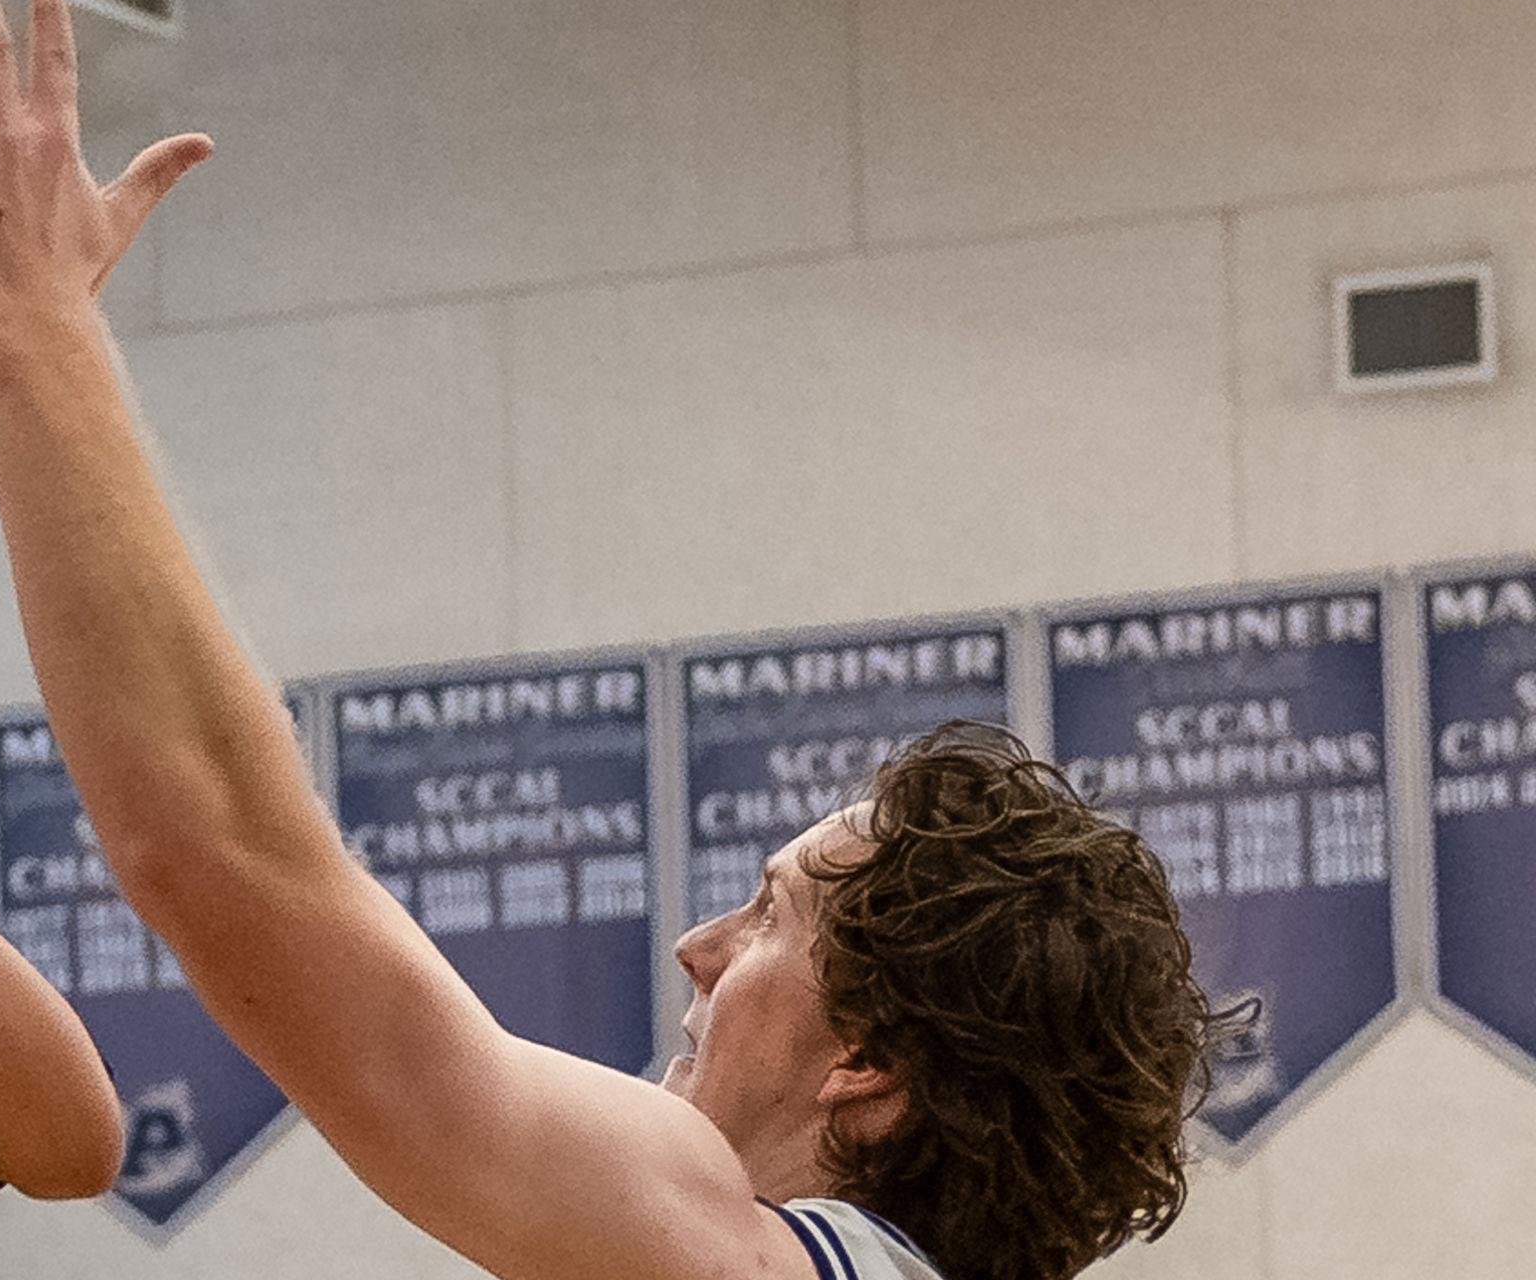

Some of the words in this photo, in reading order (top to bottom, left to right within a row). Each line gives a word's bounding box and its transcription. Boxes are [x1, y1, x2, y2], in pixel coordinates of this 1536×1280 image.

[1056, 597, 1377, 666] MARINER
[690, 634, 999, 697] MARINER
[341, 670, 640, 730] MARINER
